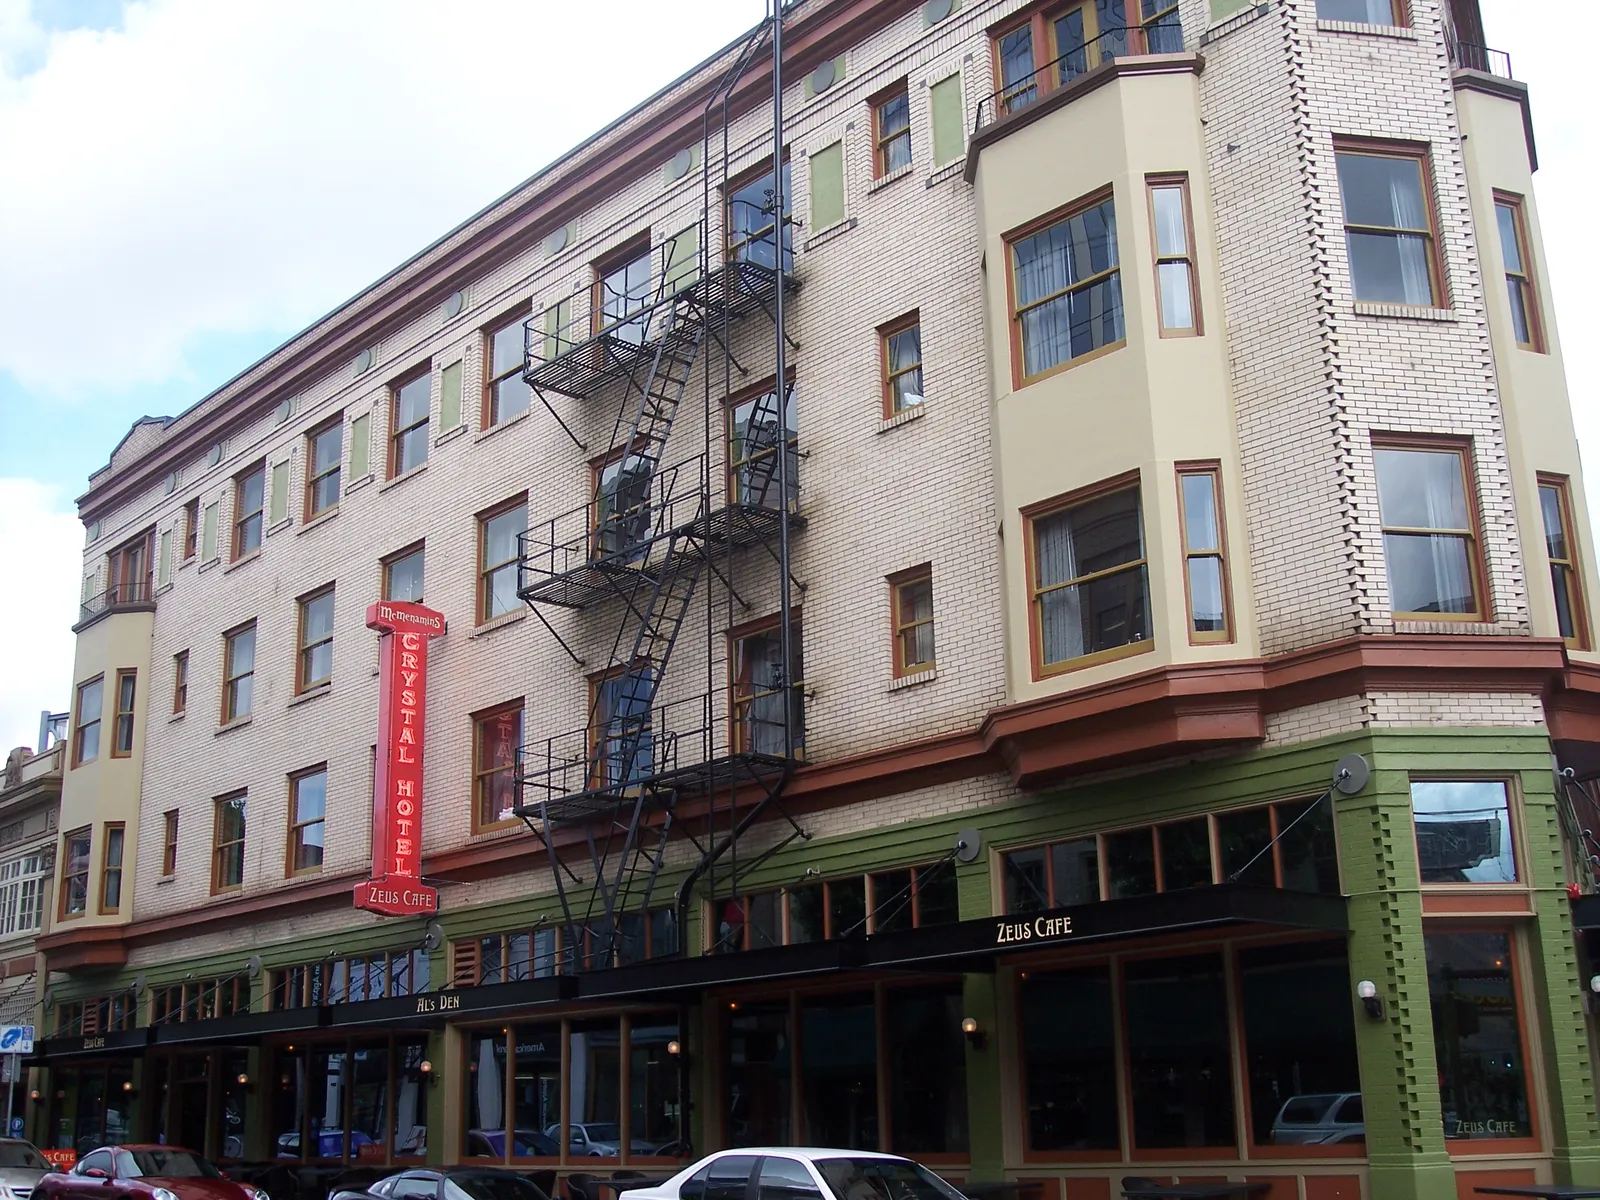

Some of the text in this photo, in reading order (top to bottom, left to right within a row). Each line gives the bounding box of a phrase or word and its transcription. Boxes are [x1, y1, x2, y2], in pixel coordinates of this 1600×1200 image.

[380, 606, 441, 629] McMenamins
[394, 632, 420, 876] CRYSTAL HOTEL
[369, 887, 432, 907] ZEUS CAFE
[996, 916, 1073, 943] ZEUS CAFE
[439, 995, 460, 1010] DEN
[1455, 1119, 1517, 1134] ZEUS CAFE
[53, 1151, 75, 1162] CAFE
